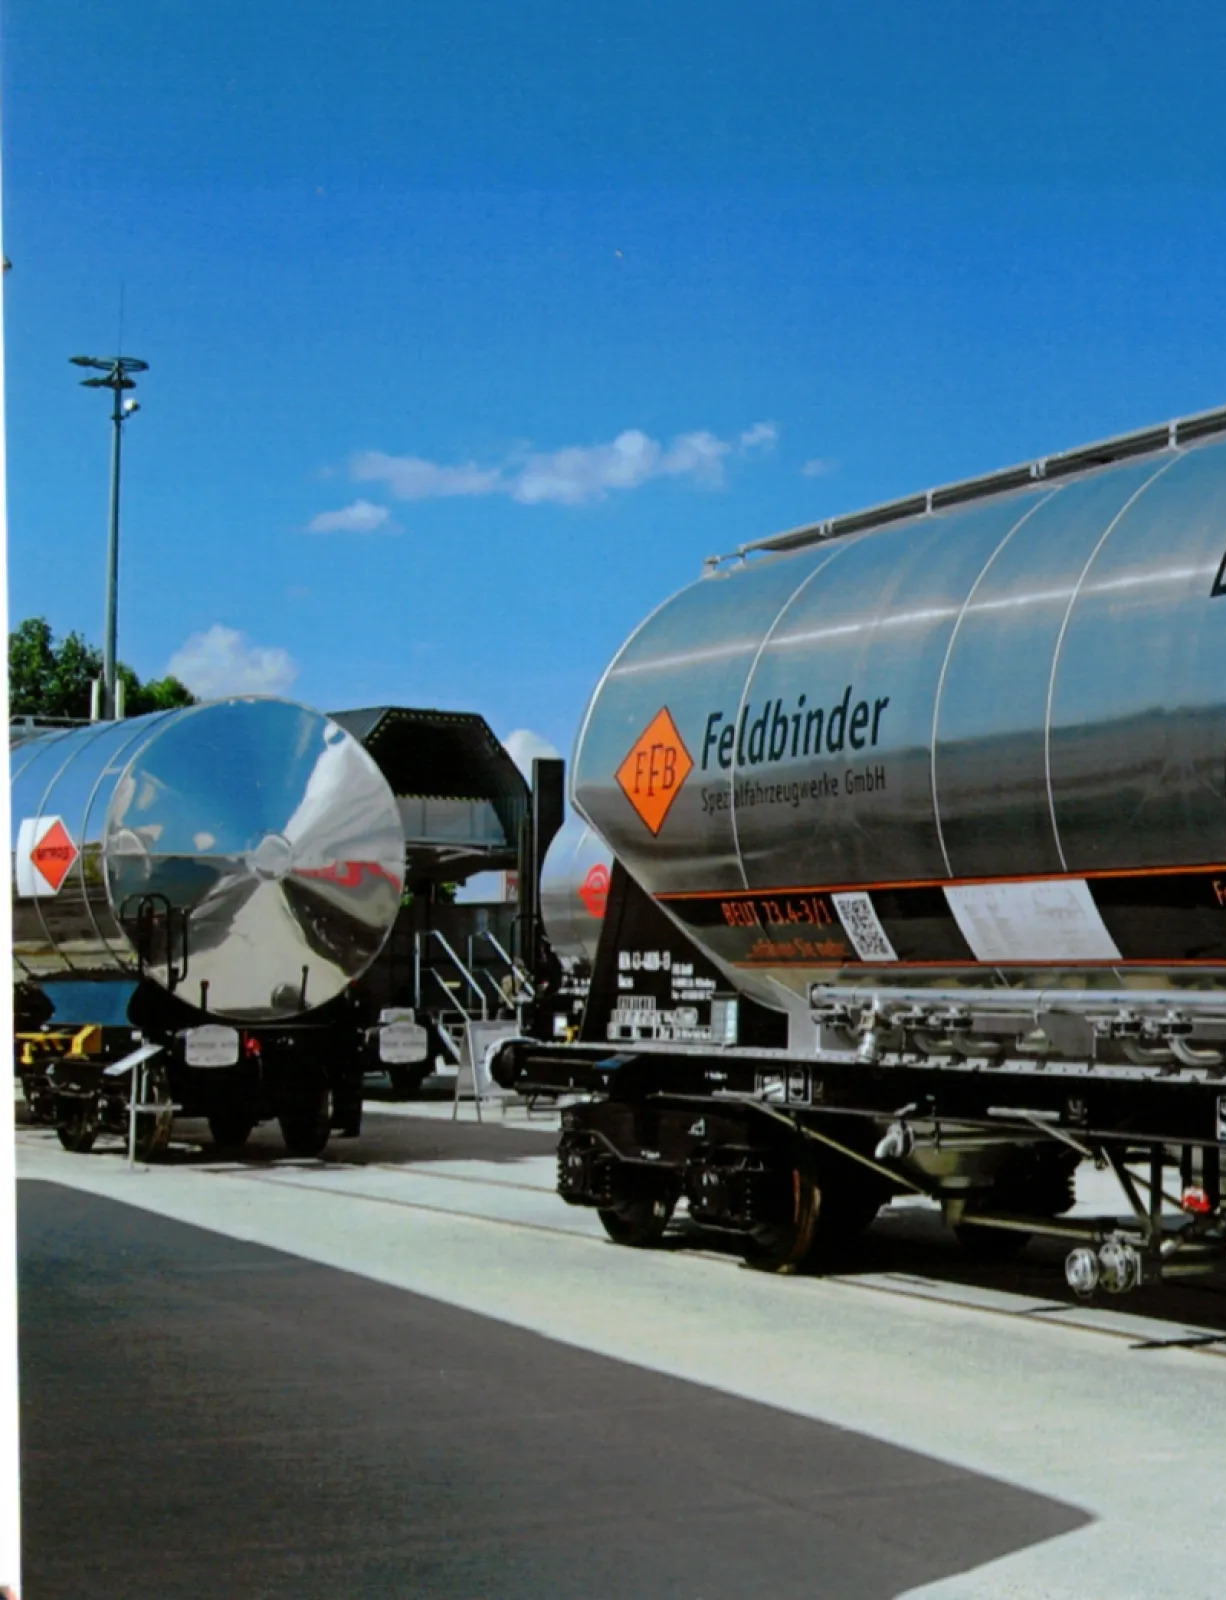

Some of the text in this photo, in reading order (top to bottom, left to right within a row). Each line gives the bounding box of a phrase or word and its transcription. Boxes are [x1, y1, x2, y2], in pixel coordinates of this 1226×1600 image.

[701, 684, 890, 770] Feldbinder
[633, 743, 678, 797] FFB
[701, 764, 886, 816] Spezialfahrzeugwerke GmbH
